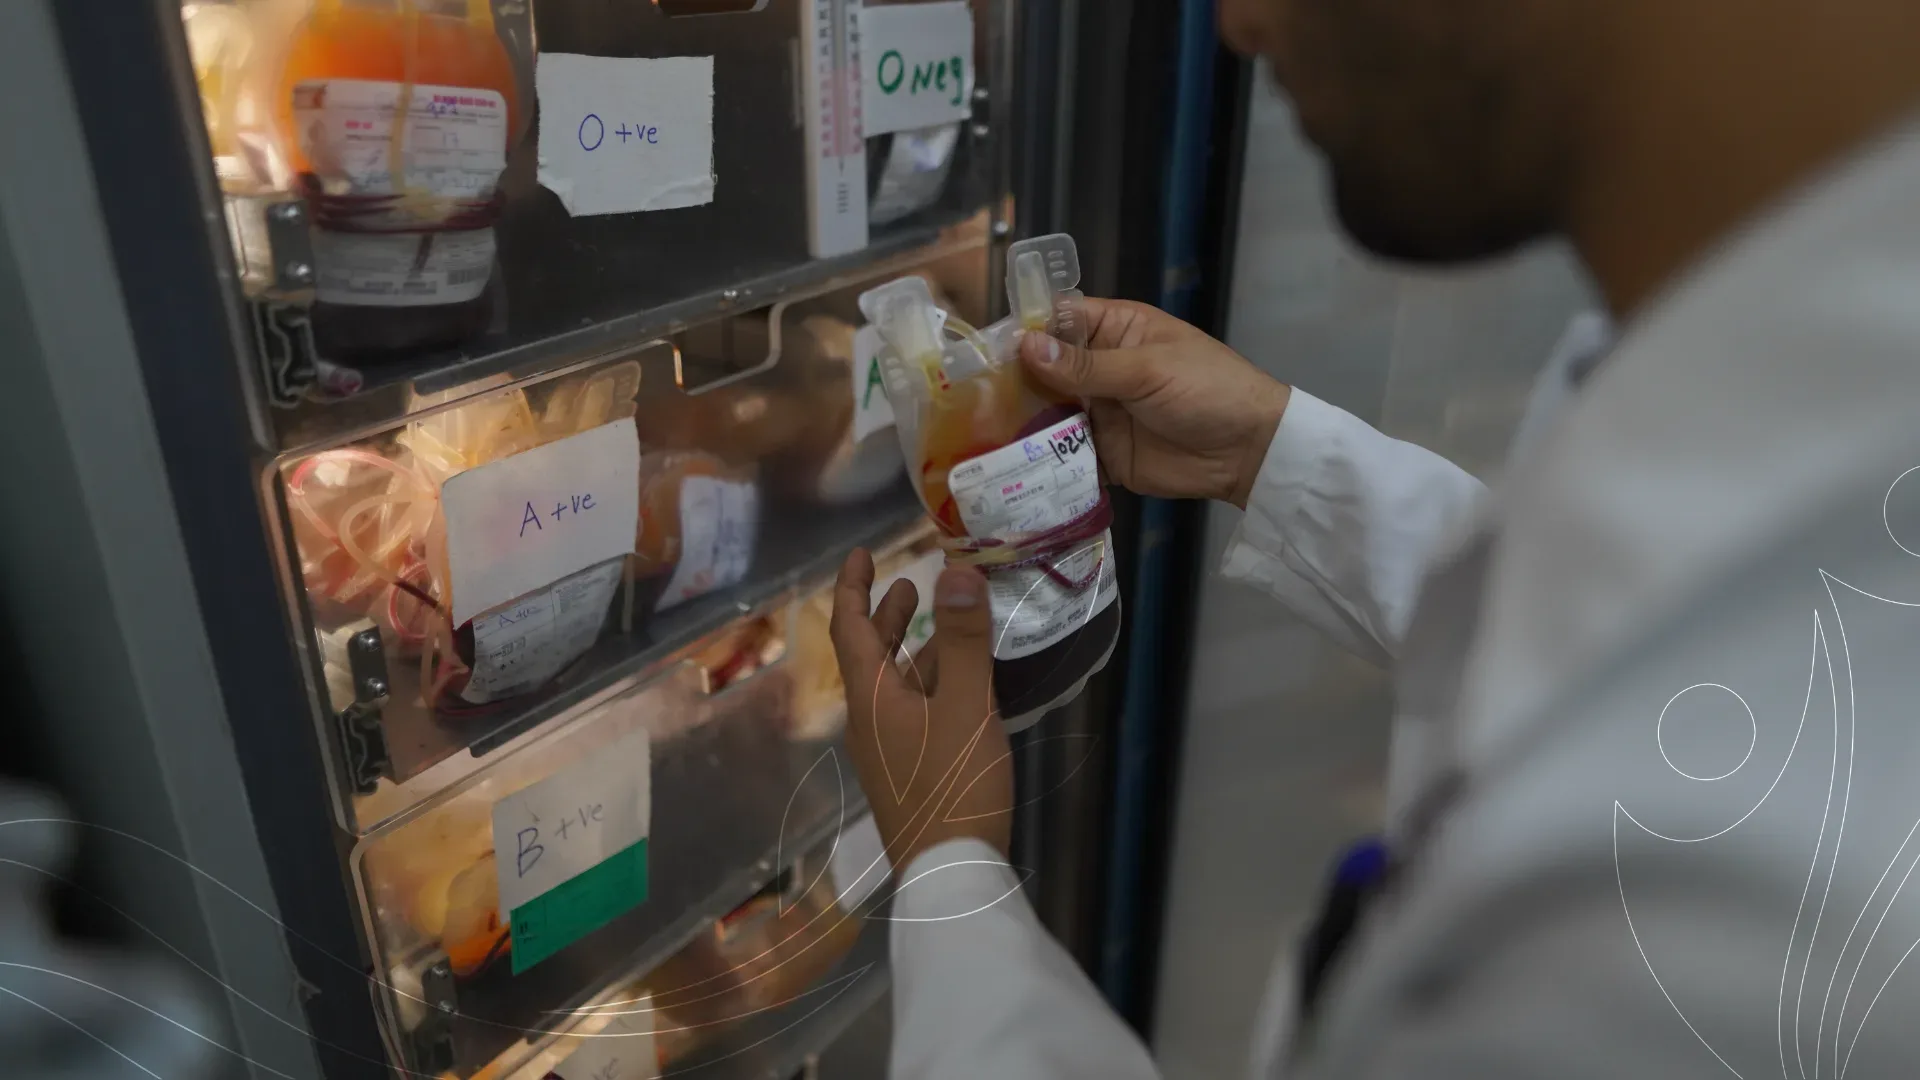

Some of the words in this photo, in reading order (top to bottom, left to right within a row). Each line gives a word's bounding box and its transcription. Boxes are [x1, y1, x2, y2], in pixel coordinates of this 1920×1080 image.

[878, 49, 904, 94] O
[578, 113, 604, 151] O
[615, 122, 658, 144] +ve
[1048, 426, 1096, 465] 1024
[520, 501, 542, 538] A
[551, 493, 597, 521] +ve
[517, 827, 544, 878] B
[555, 803, 604, 840] +ve
